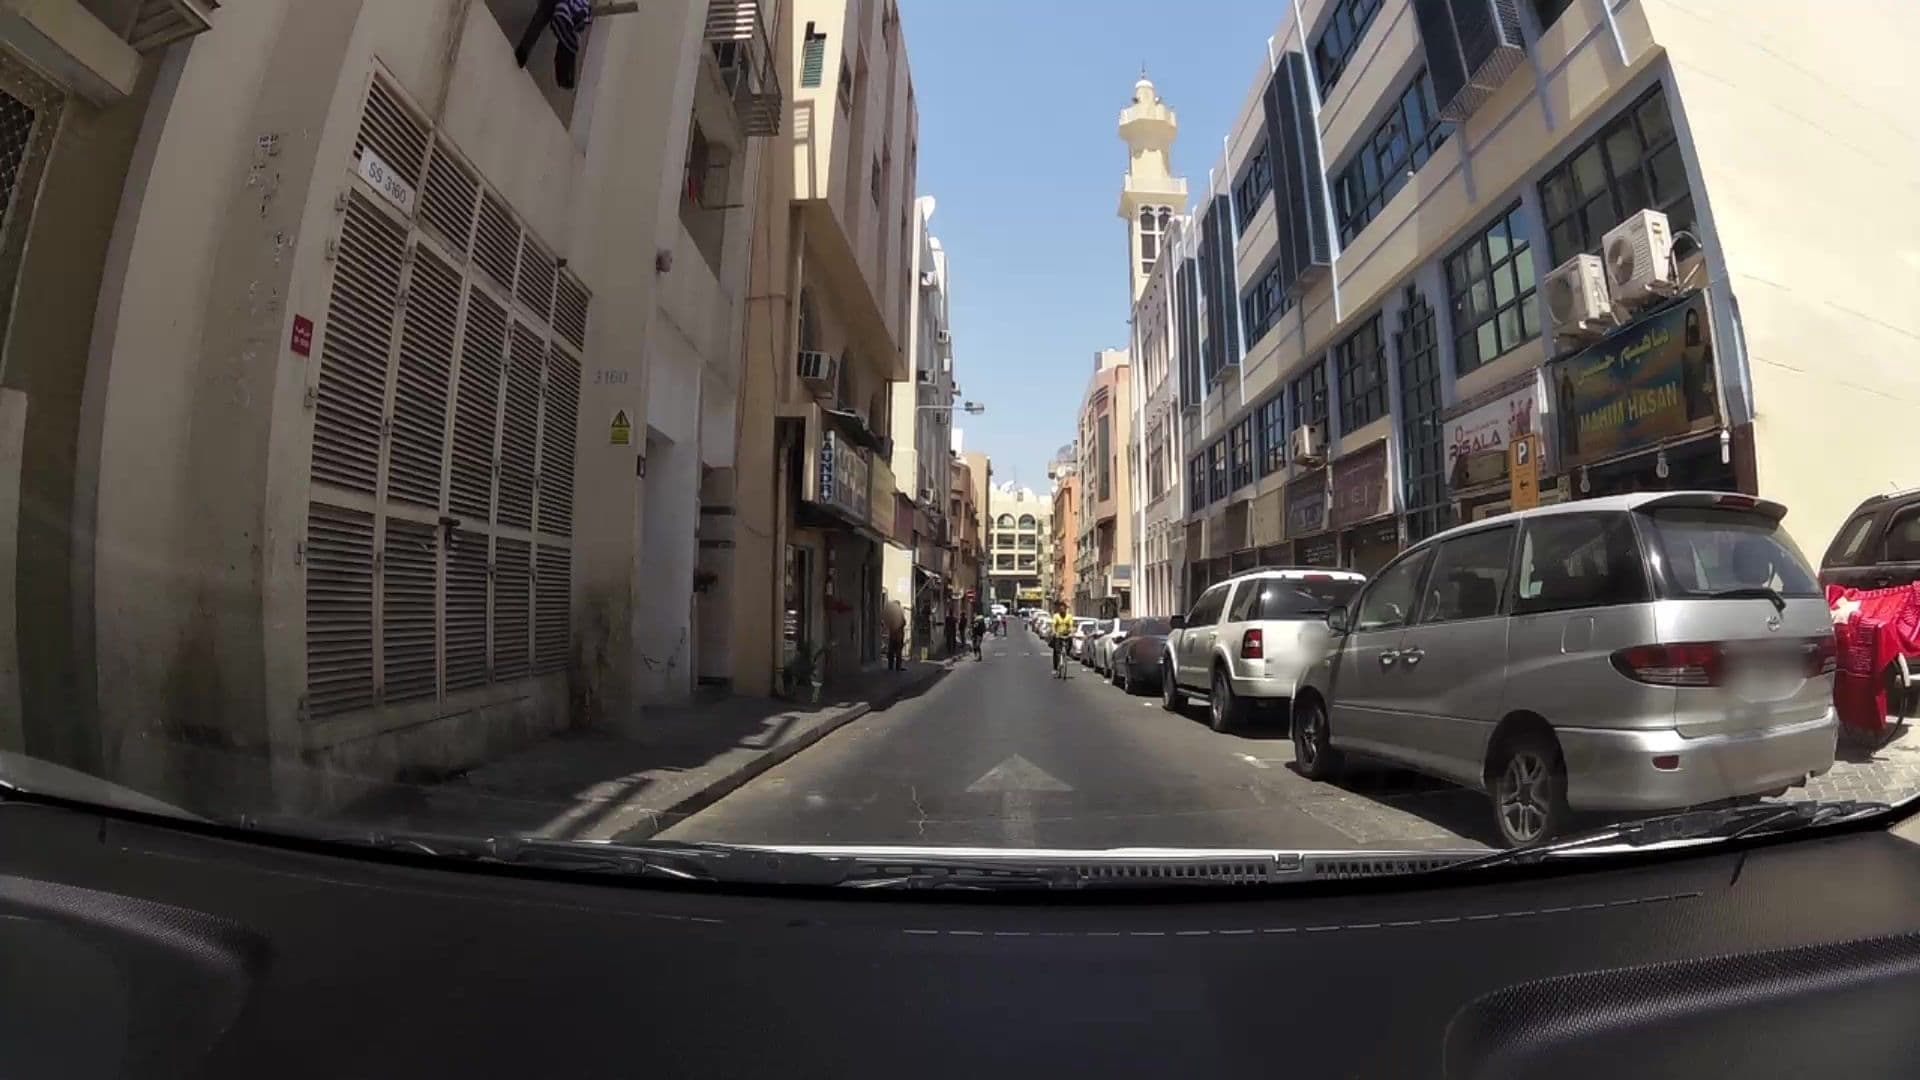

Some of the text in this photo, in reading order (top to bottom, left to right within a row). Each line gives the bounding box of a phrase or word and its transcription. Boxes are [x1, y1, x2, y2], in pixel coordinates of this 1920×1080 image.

[369, 162, 406, 204] SS 3160
[1627, 381, 1678, 421] HASAN
[820, 431, 833, 502] LAUNDRY
[1517, 441, 1527, 465] P
